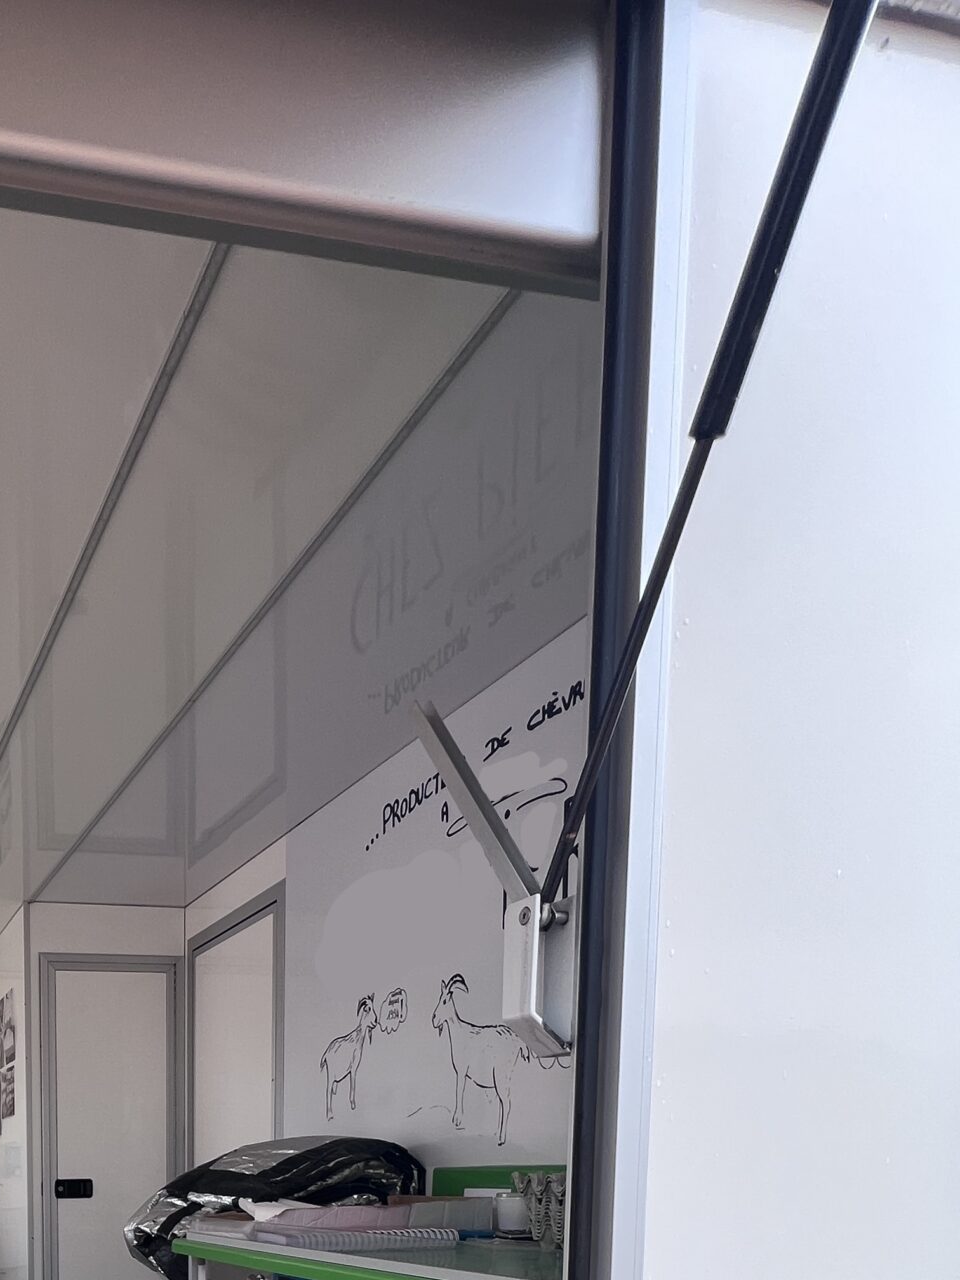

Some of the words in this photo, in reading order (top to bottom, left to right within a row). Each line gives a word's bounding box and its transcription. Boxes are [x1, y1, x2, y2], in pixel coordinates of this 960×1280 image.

[483, 726, 512, 762] DE
[527, 679, 585, 731] CHÈVR
[441, 800, 449, 823] A
